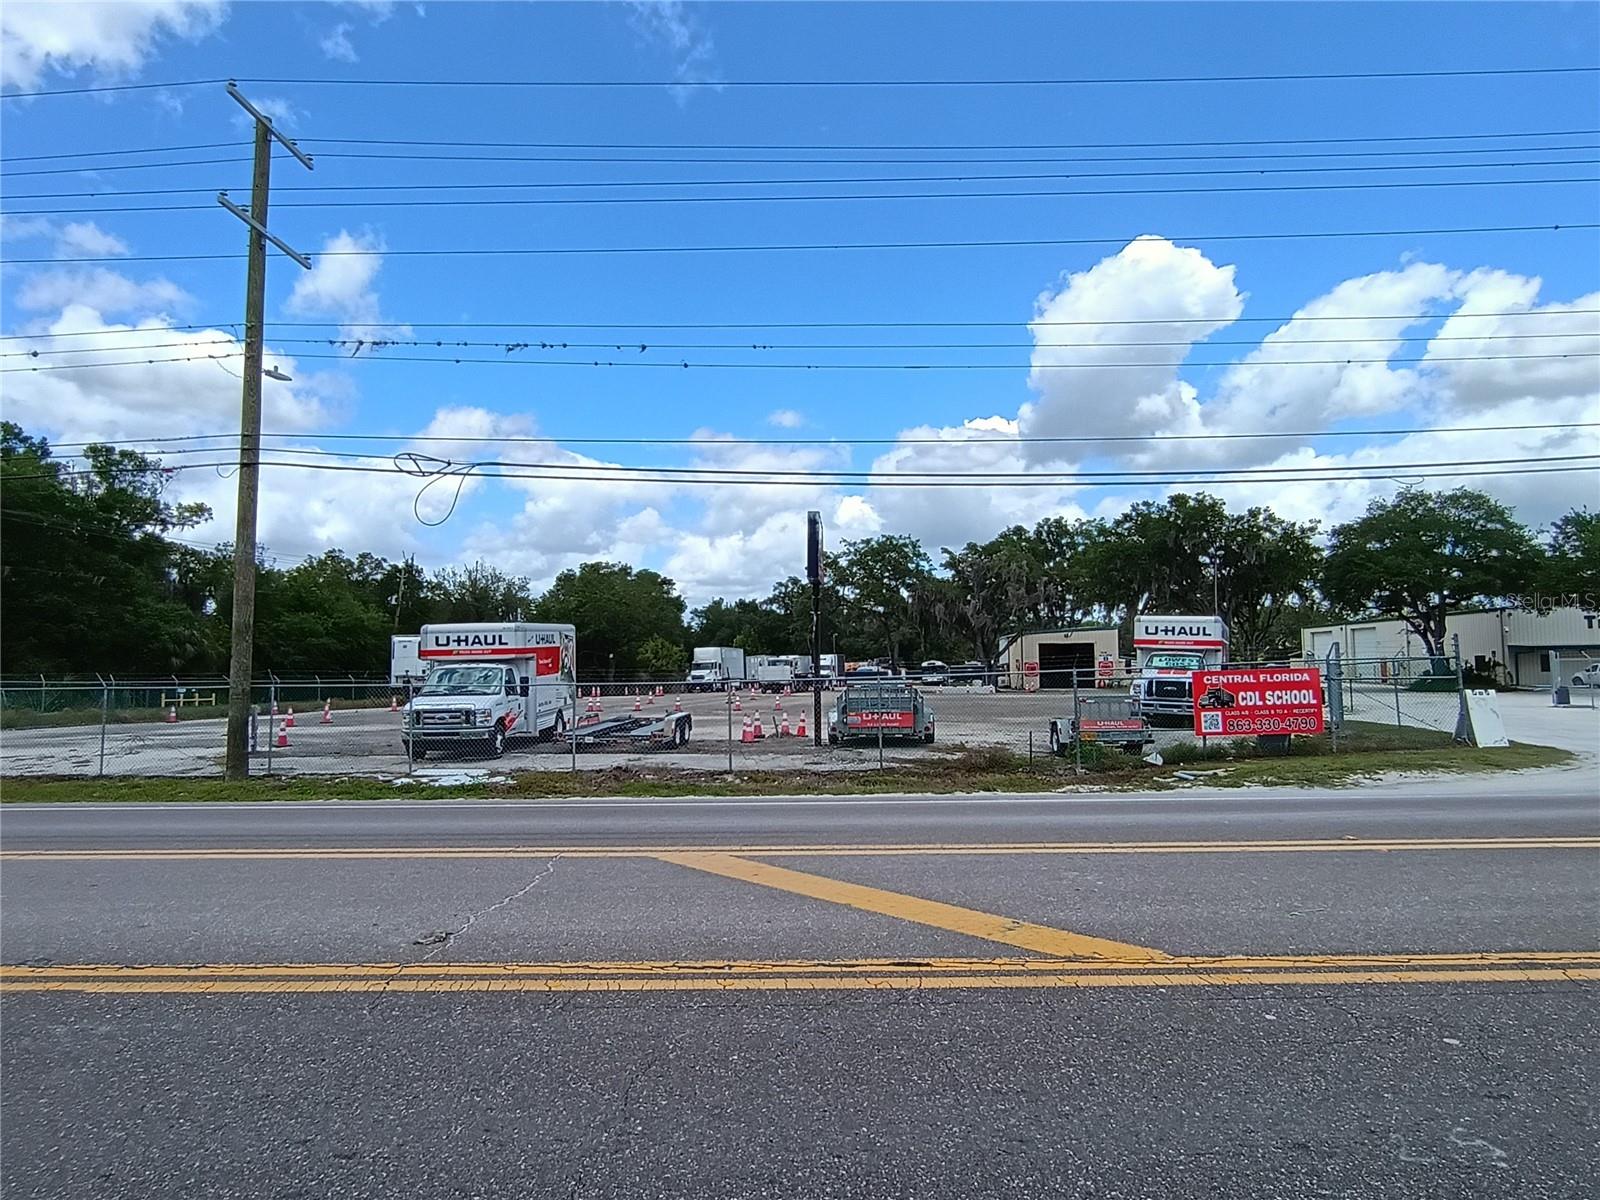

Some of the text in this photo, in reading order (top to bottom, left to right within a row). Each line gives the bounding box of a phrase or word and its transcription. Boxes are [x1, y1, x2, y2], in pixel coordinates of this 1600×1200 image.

[1145, 626, 1212, 636] U-HAUL
[435, 635, 508, 647] U-HAUL
[535, 633, 556, 645] U-HAUL
[1203, 673, 1310, 684] CENTRAL FLORIDA
[1238, 689, 1317, 706] CDL SCHOOL
[1226, 717, 1317, 732] 863-330-4790
